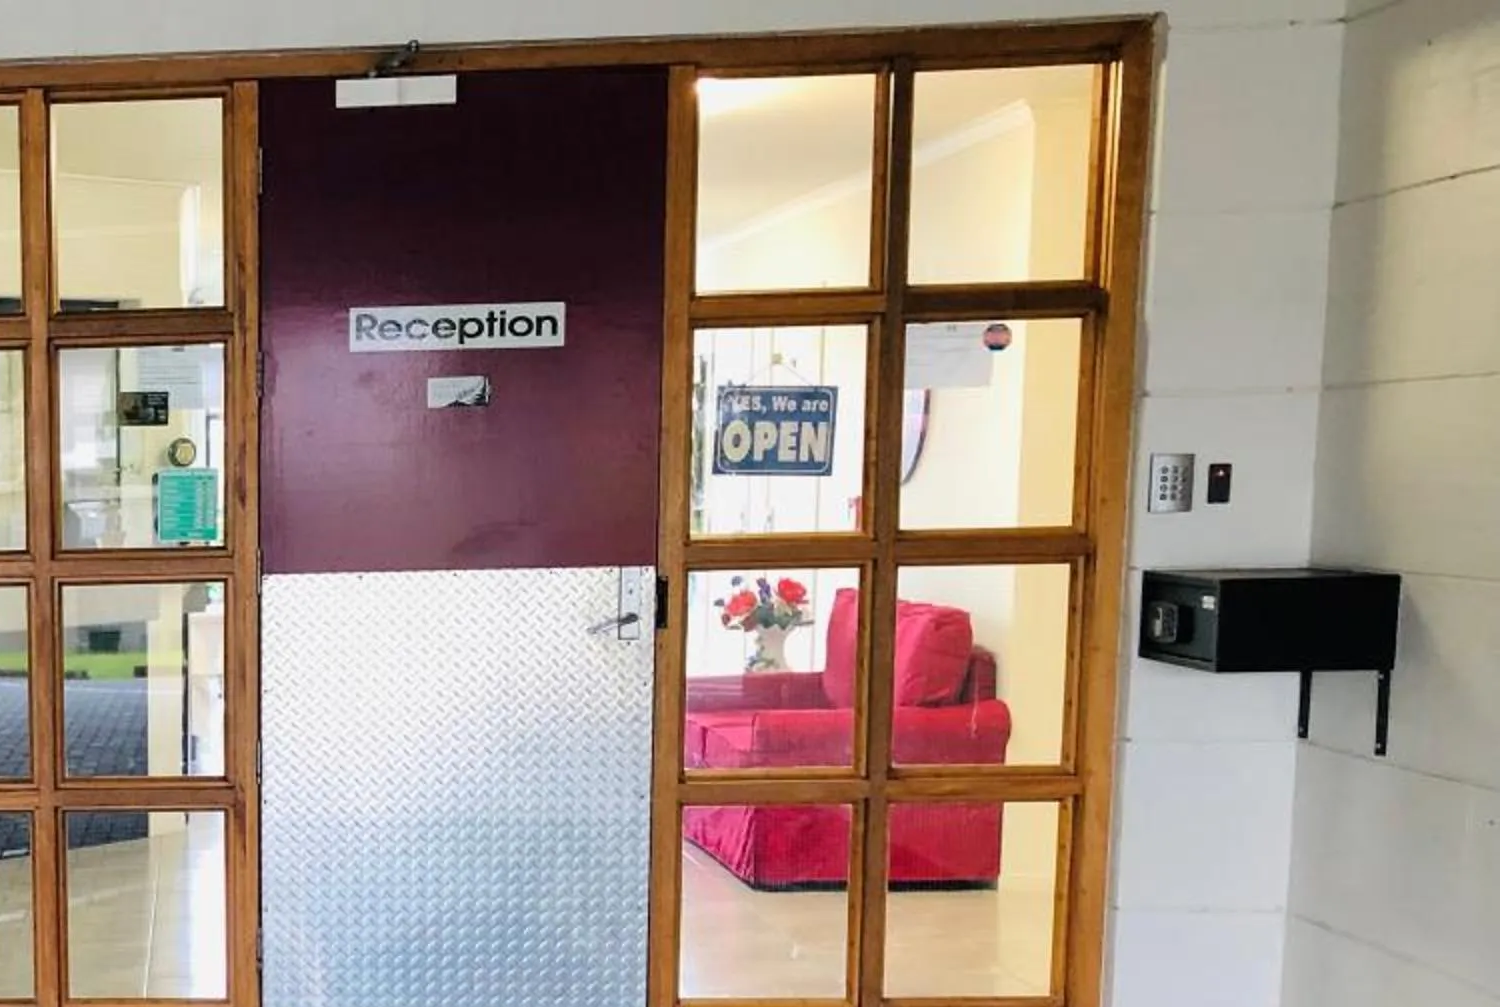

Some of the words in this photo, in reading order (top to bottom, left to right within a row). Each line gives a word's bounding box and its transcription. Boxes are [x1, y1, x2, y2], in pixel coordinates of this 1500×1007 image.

[355, 310, 559, 344] Reception
[772, 396, 797, 412] We
[802, 399, 829, 412] are
[722, 420, 828, 463] OPEN
